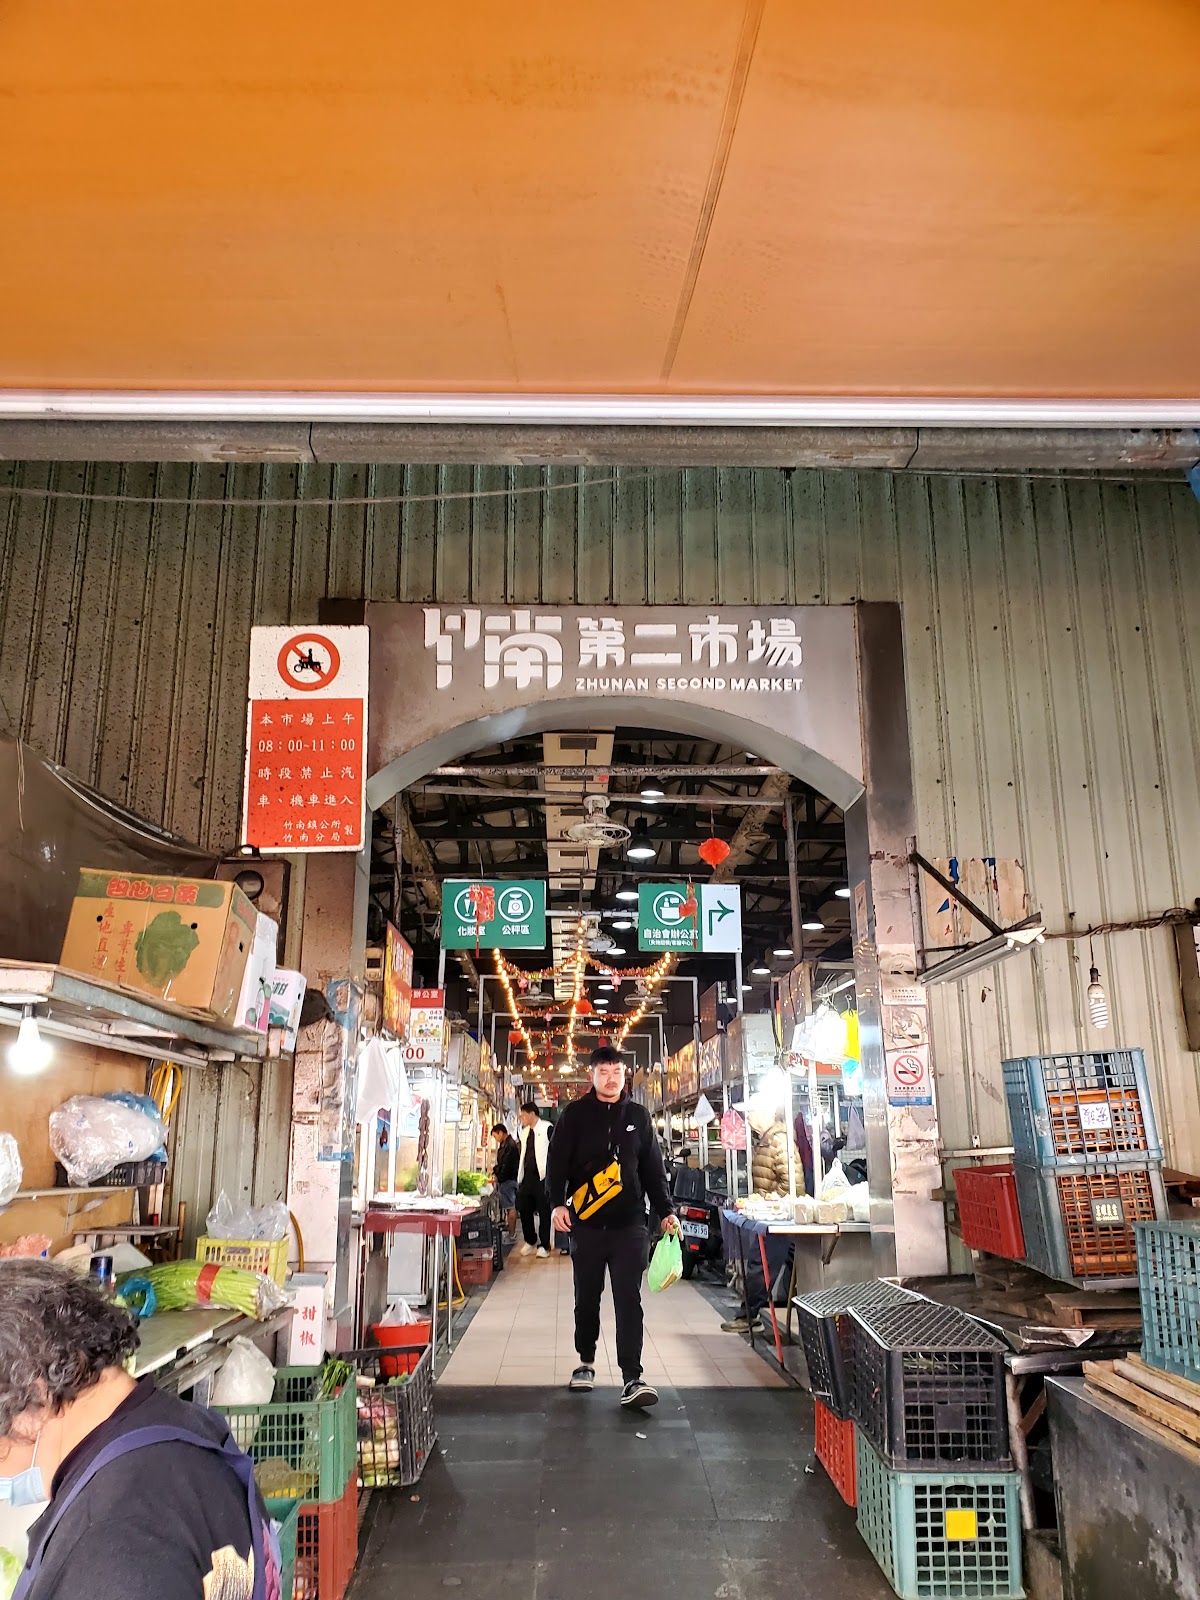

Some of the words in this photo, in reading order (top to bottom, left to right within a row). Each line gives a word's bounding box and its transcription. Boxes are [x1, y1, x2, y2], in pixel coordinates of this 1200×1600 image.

[576, 615, 803, 669] 第二市場
[575, 677, 649, 692] ZHUNAN
[656, 676, 726, 691] SECOND
[730, 677, 804, 692] MARKET
[259, 712, 355, 727] 本市場上午
[257, 766, 355, 781] 時段禁止汽
[283, 819, 341, 831] 竹南鎮公所
[344, 825, 354, 836] 製
[283, 831, 341, 843] 竹南分局
[411, 990, 439, 999] 辦公室
[300, 1305, 317, 1346] 甜椒
